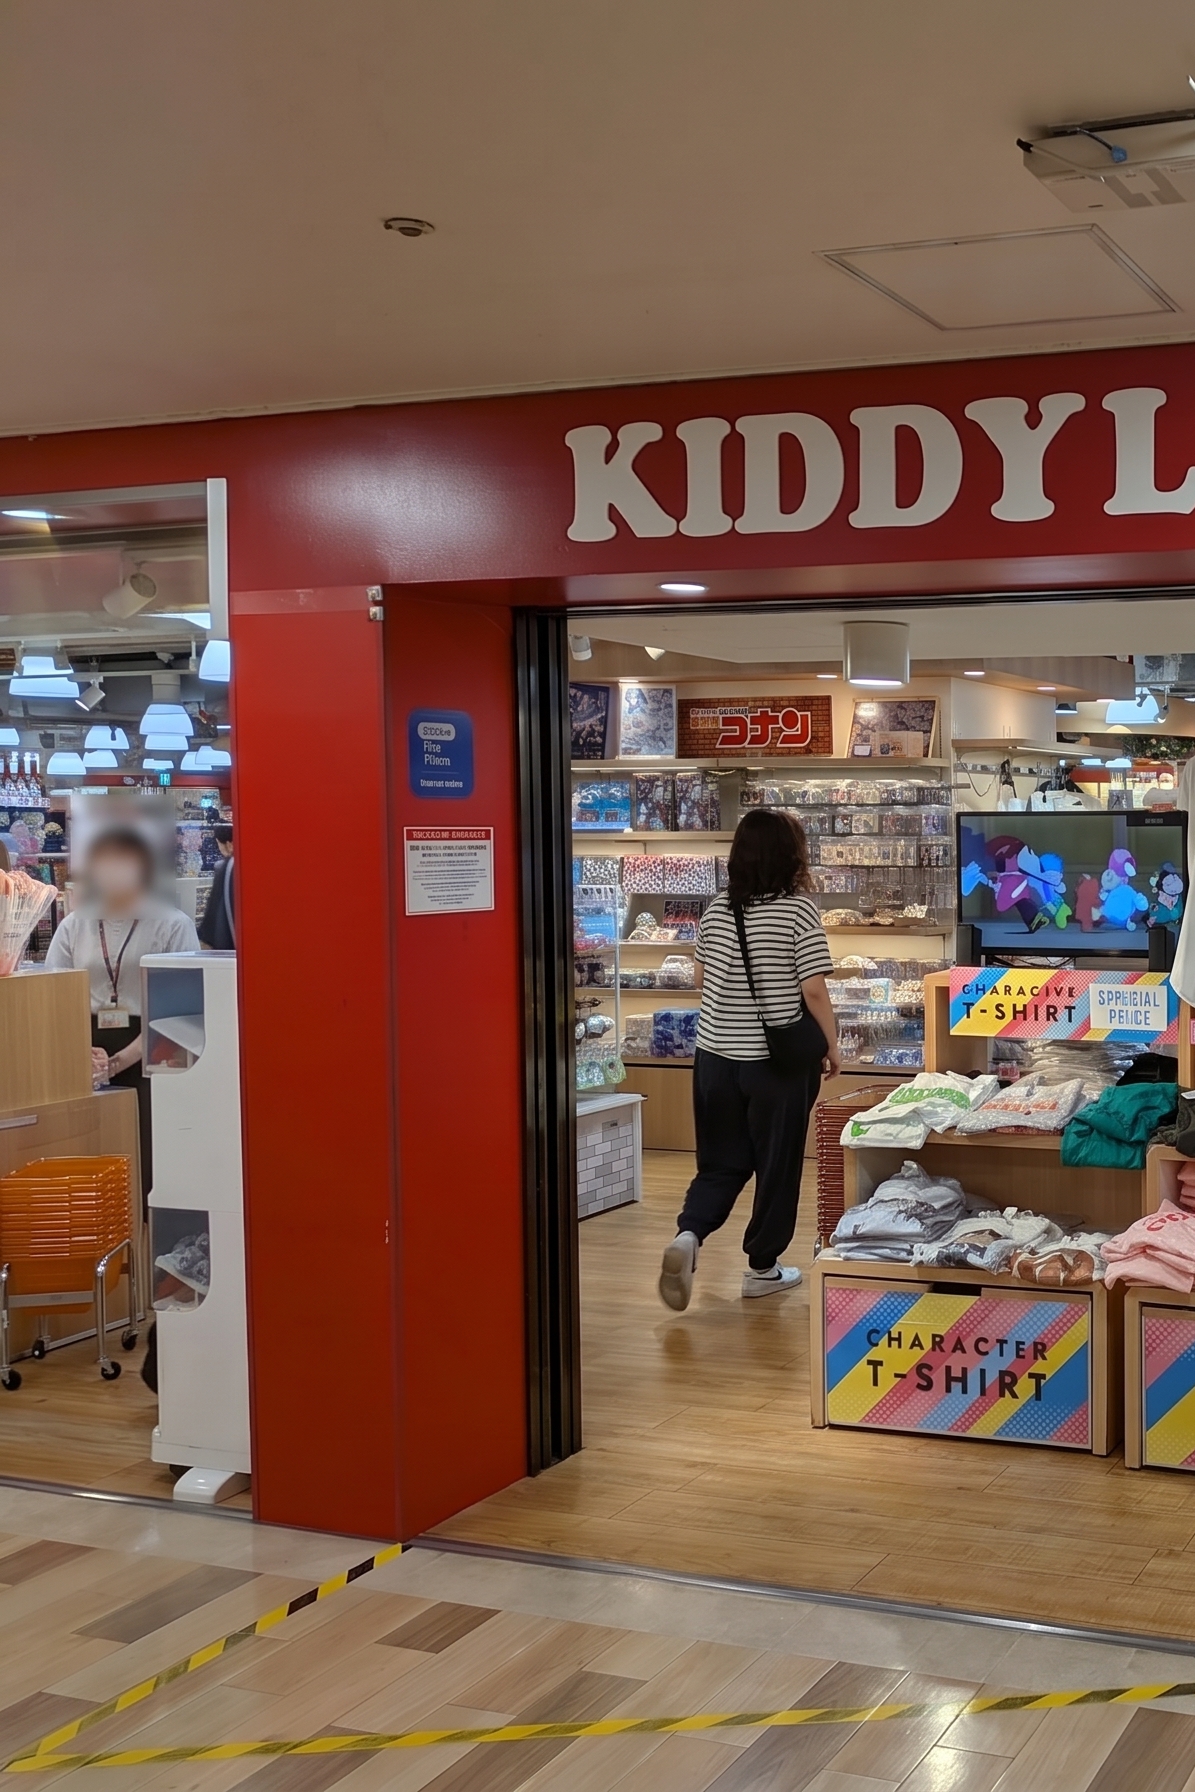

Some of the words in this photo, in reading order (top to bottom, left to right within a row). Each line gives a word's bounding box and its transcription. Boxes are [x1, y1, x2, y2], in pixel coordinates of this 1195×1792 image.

[715, 707, 812, 749] コナン
[962, 1002, 1076, 1023] T-SHIRT
[865, 1328, 1049, 1361] CHARACTER
[865, 1358, 1047, 1401] T-SHIRT
